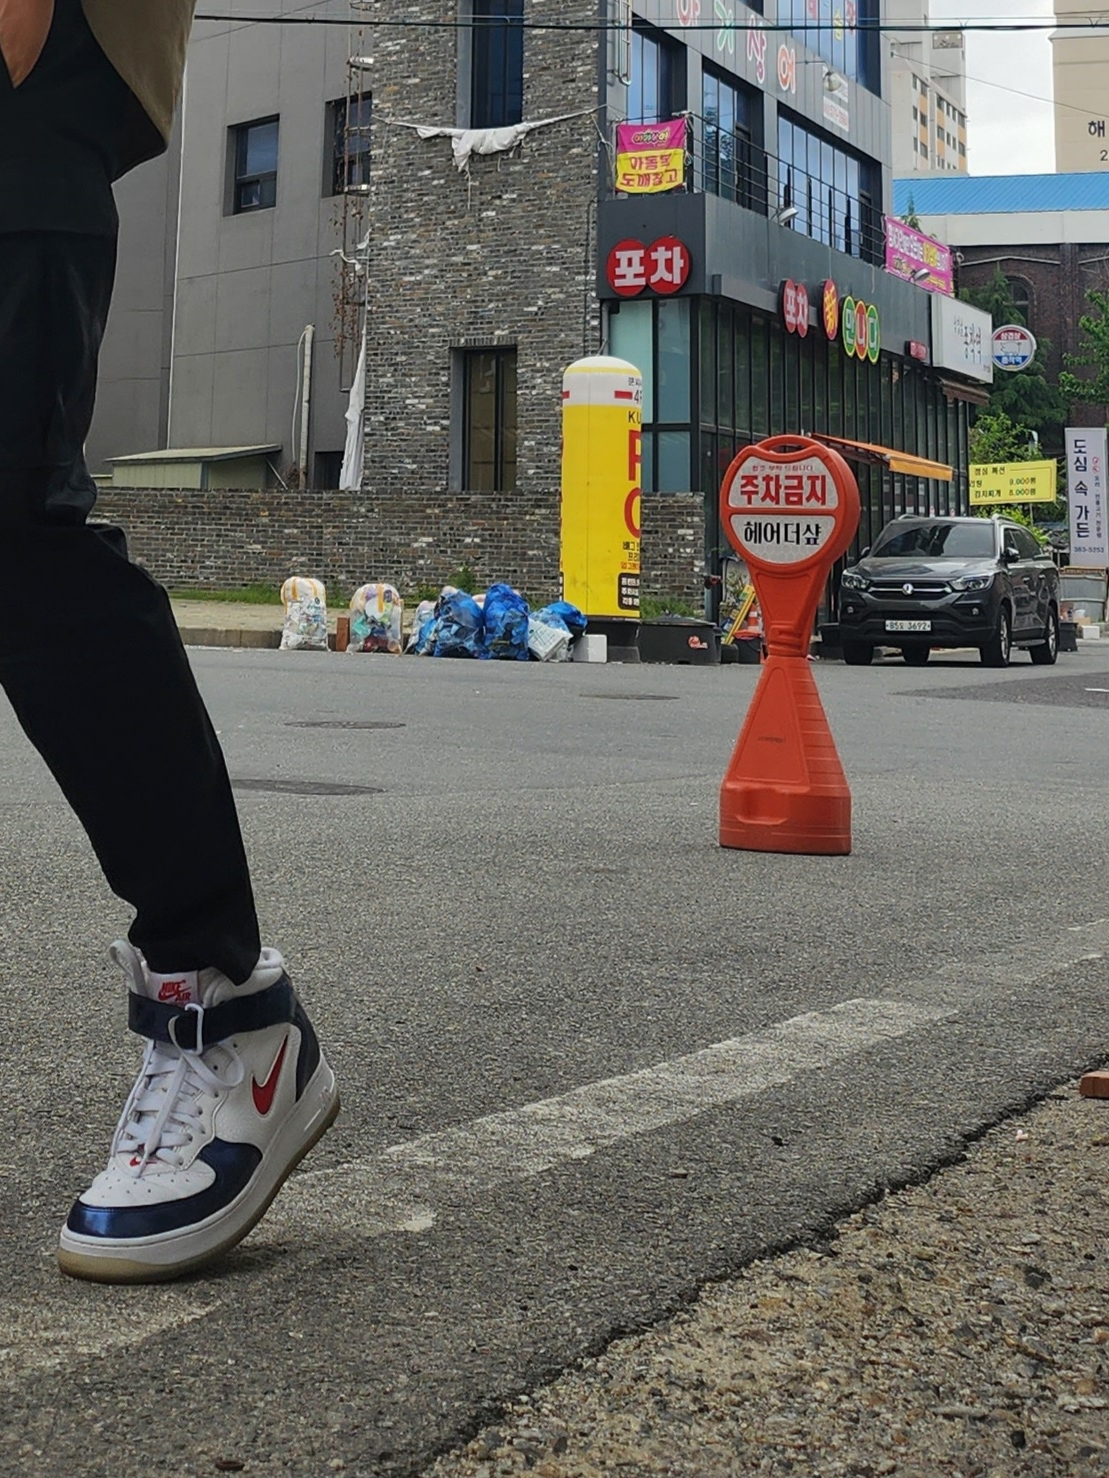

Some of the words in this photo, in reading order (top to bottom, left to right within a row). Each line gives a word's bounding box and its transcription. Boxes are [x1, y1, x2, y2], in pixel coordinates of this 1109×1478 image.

[1087, 120, 1106, 138] 해
[614, 245, 685, 288] 포차
[784, 287, 809, 327] 포차
[1074, 439, 1088, 472] 도심
[740, 474, 826, 506] 주차금지
[1074, 480, 1088, 496] 속
[1074, 505, 1090, 538] 가든
[161, 981, 183, 996] NIKE
[174, 993, 192, 1002] AIR
